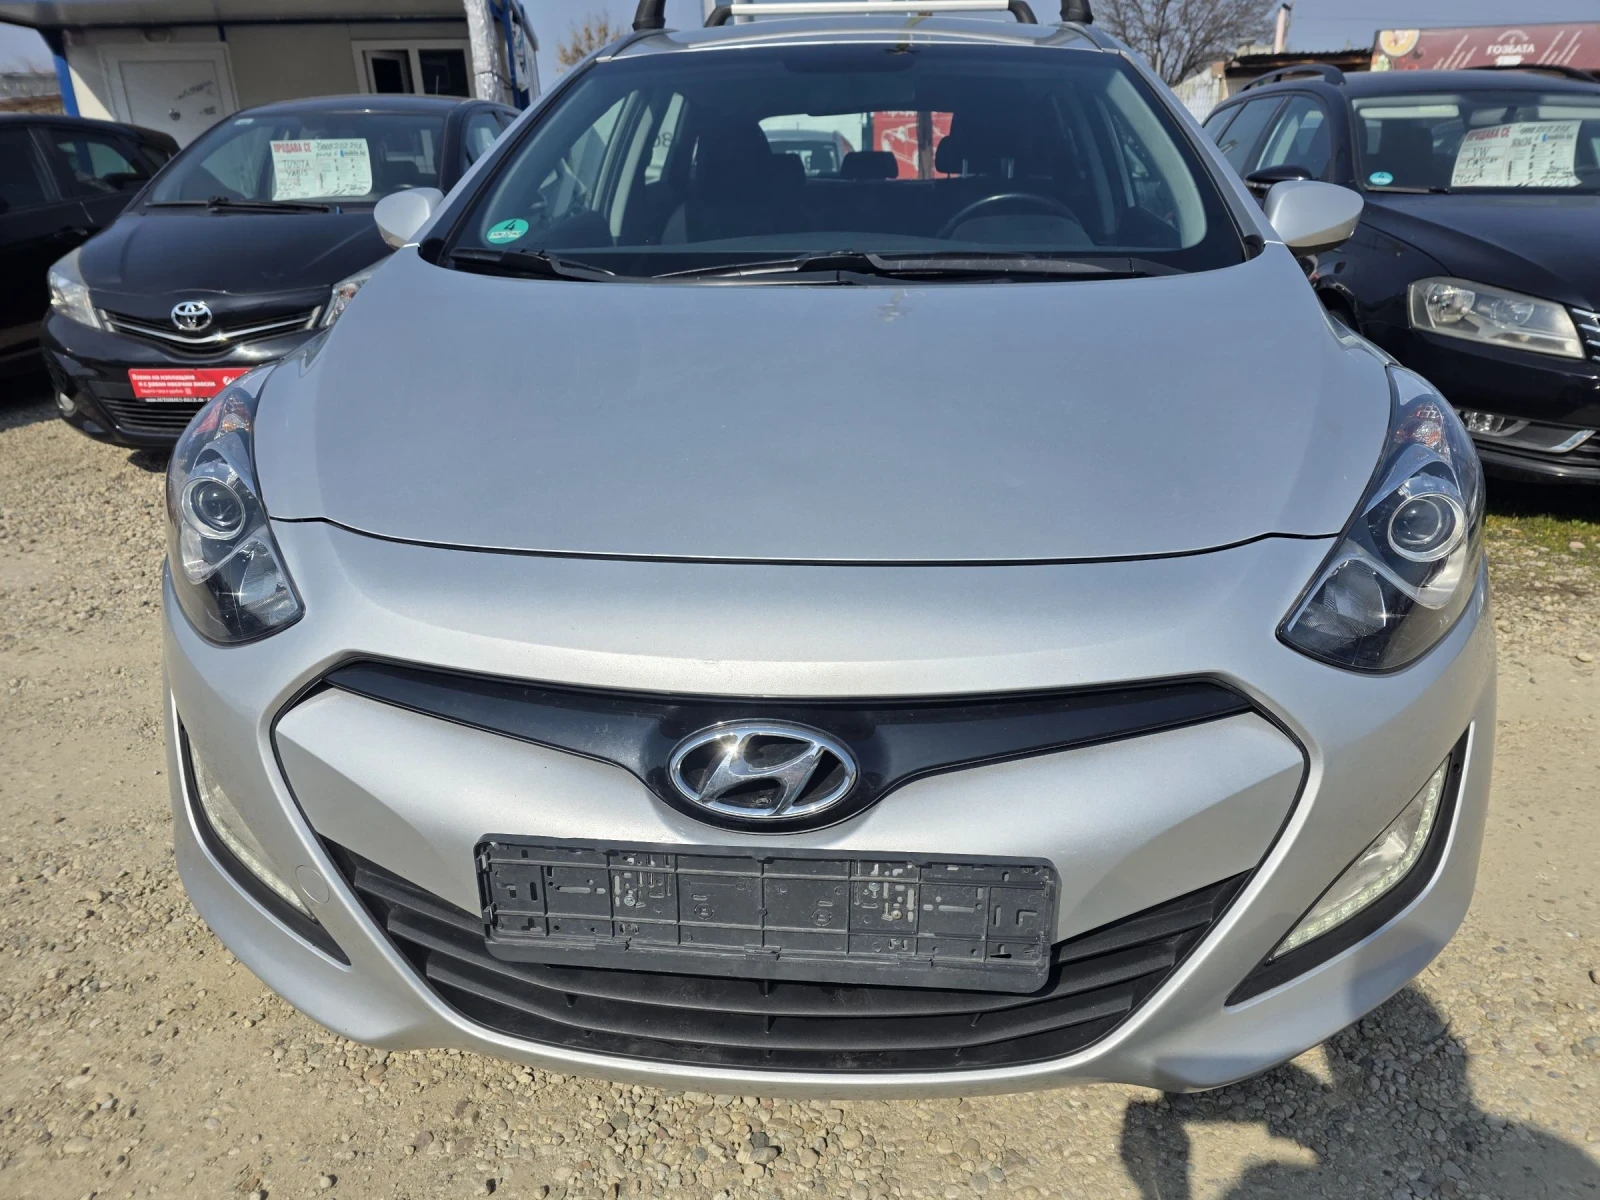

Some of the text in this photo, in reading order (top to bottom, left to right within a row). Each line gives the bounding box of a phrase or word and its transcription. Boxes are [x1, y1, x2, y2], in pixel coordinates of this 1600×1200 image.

[1486, 44, 1535, 56] ГОЗБАТА
[273, 142, 312, 153] ПРОДАВА СЕ
[283, 160, 310, 168] TOYOTA
[285, 169, 308, 178] YARIS
[503, 219, 517, 231] 4
